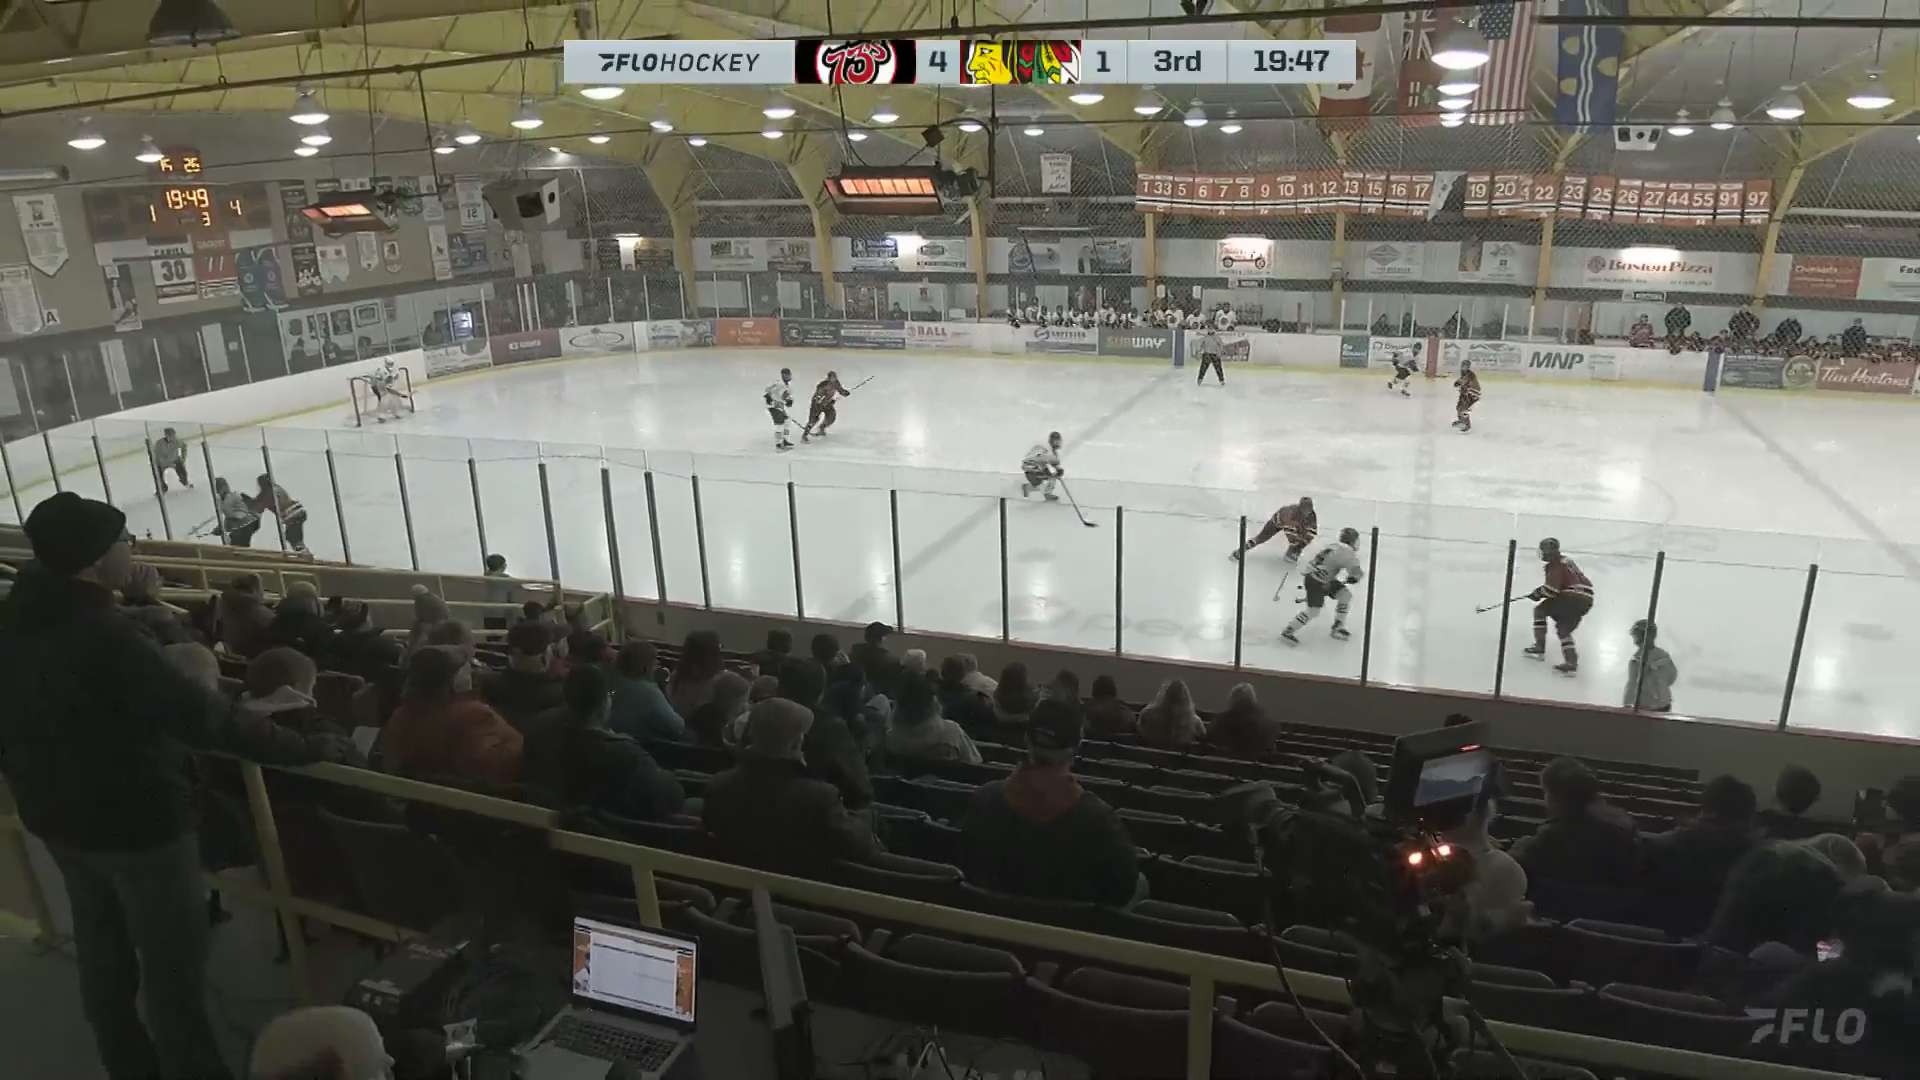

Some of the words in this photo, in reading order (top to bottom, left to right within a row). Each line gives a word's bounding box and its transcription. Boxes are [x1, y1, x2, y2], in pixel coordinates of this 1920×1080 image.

[166, 188, 209, 210] 19:49
[1143, 181, 1149, 193] 1
[1153, 182, 1172, 195] 33
[1178, 183, 1187, 196] 5
[1198, 185, 1207, 198] 6
[1219, 185, 1228, 197] 7
[1240, 185, 1249, 198] 8
[1261, 184, 1270, 197] 9
[1278, 183, 1294, 196] 10
[1302, 182, 1314, 195] 11
[1321, 181, 1337, 194] 12
[1344, 180, 1359, 194] 13
[1368, 182, 1382, 196] 15
[1391, 183, 1406, 197] 16
[1414, 184, 1430, 197] 17
[1470, 183, 1486, 198] 19
[1494, 181, 1515, 196] 20
[1535, 186, 1553, 200] 22
[1565, 186, 1584, 199] 23
[1593, 188, 1611, 202] 25
[1618, 190, 1638, 203] 26
[1645, 192, 1664, 206] 27
[1667, 192, 1689, 205] 44
[1692, 193, 1714, 207] 55
[1720, 192, 1738, 205] 91
[1748, 192, 1768, 206] 97
[150, 204, 157, 222] 1
[230, 199, 242, 216] 4
[202, 212, 211, 226] 3
[160, 260, 187, 281] 30
[1669, 262, 1713, 274] Pizza
[46, 311, 58, 323] A
[917, 326, 947, 336] BALL
[1107, 337, 1166, 350] SUBWAY
[1529, 352, 1584, 369] MNP
[1821, 366, 1848, 383] Tim
[1850, 367, 1910, 387] Hortons
